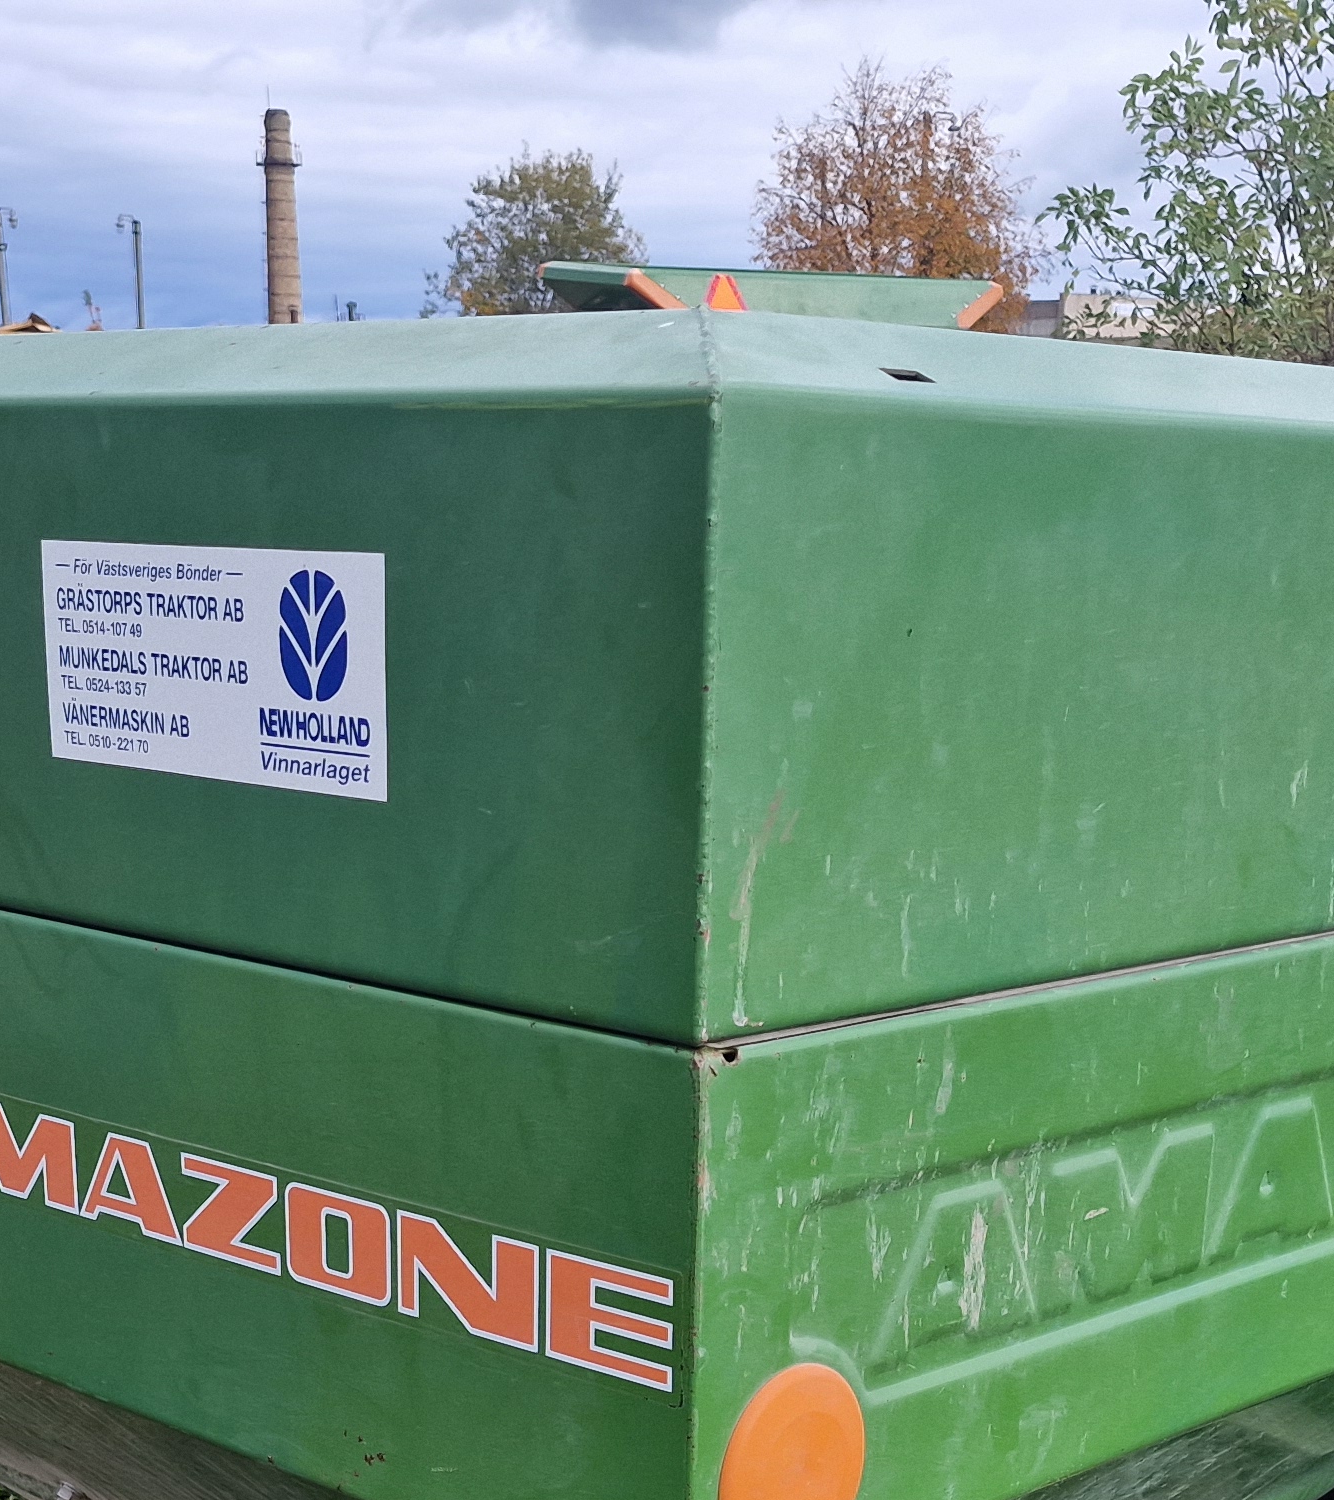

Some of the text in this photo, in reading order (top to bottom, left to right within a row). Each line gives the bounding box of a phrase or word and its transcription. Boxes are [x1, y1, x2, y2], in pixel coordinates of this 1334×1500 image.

[73, 558, 223, 582] För Västsveriges Bönder
[56, 582, 245, 623] GRÄSTORPS TRAKTOR AB
[58, 617, 81, 633] TEL.
[59, 645, 249, 685] MUNKEDALS TRAKTOR AB
[61, 674, 83, 690] TEL.
[62, 697, 190, 738] VÄNERMASKIN AB
[259, 707, 371, 747] NEW HOLLAND
[64, 730, 86, 746] TEL.
[260, 750, 371, 785] Vinnarlaget
